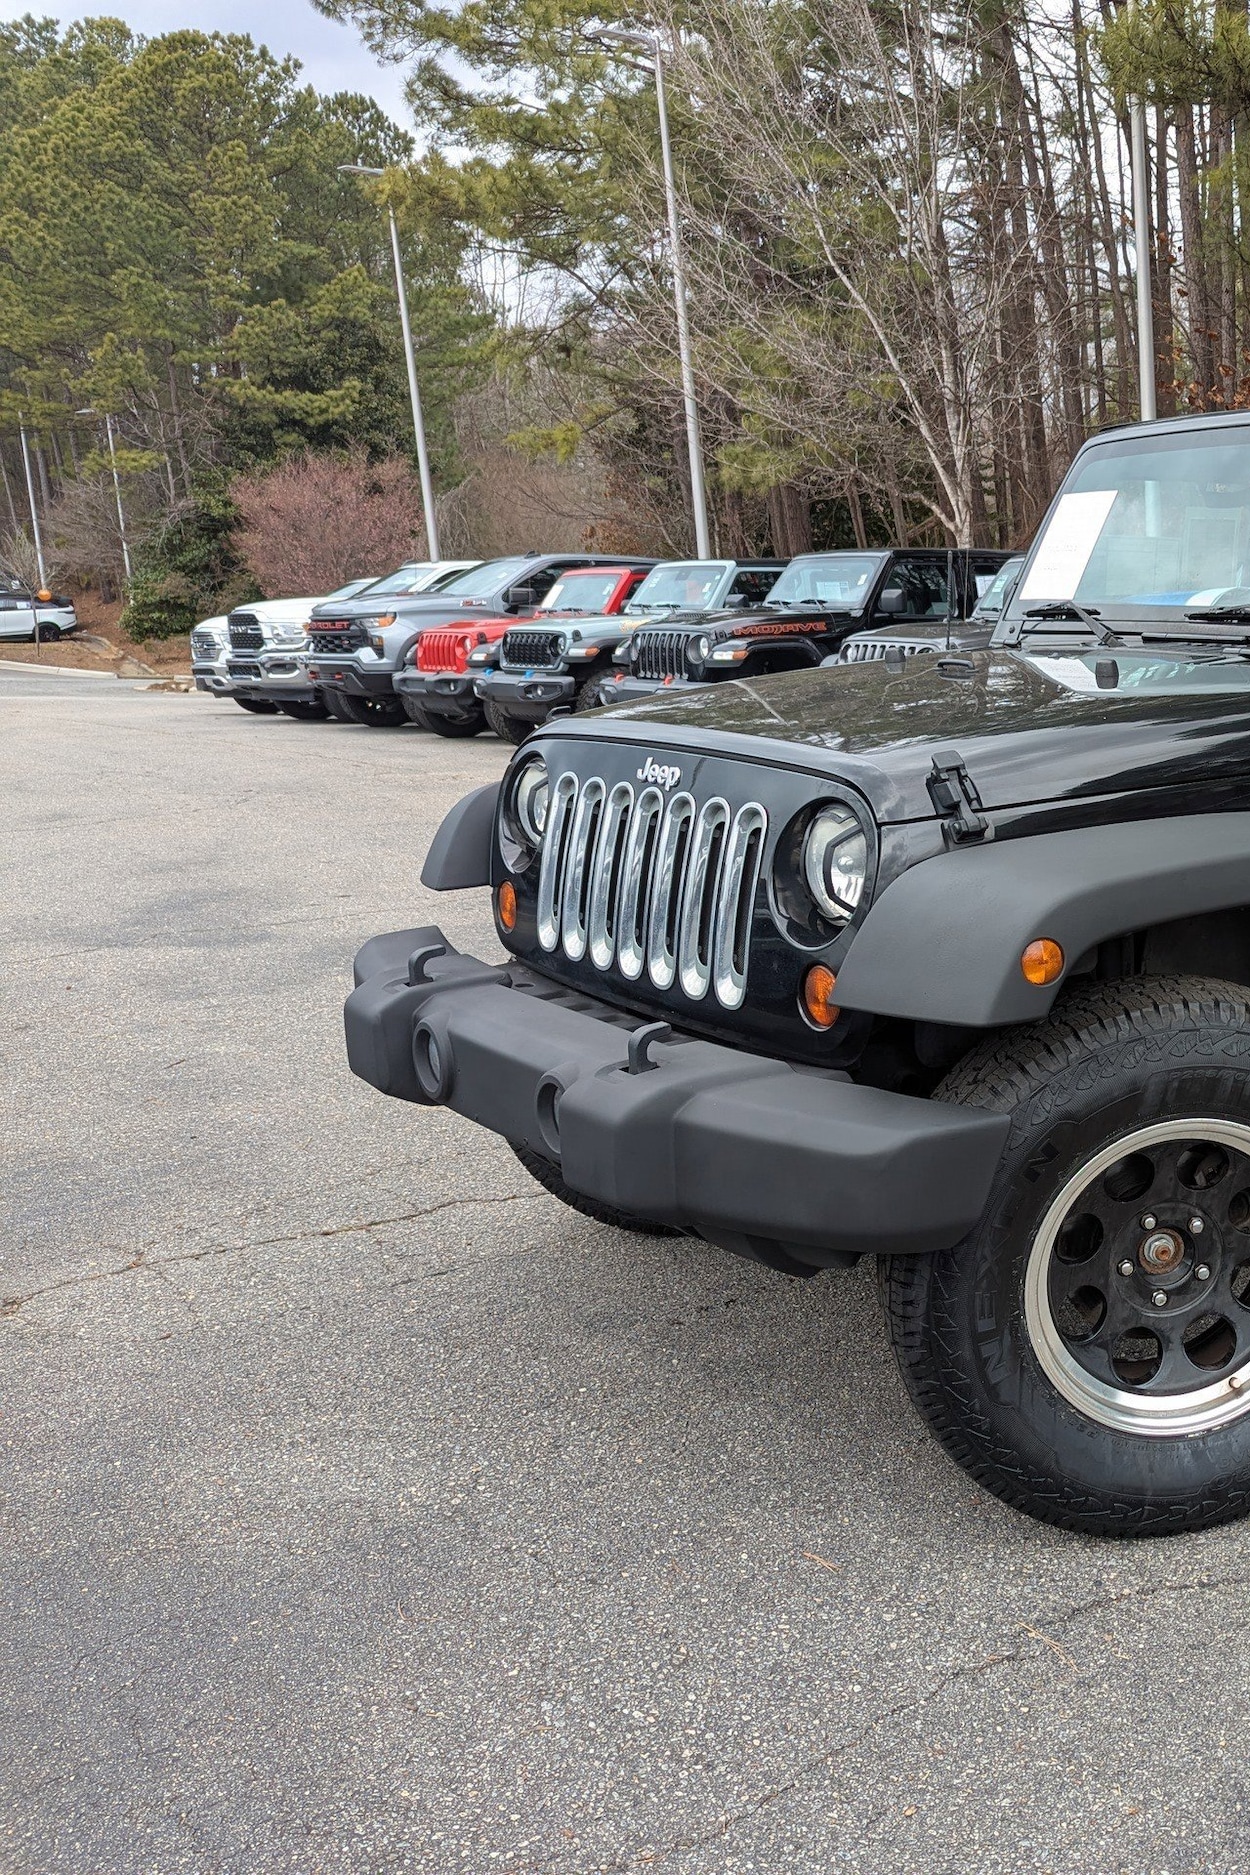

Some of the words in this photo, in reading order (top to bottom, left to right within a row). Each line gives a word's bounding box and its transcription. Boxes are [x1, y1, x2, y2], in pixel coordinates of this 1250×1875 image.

[731, 621, 827, 637] MOJAVE
[636, 756, 681, 792] Jeep
[973, 1136, 1062, 1385] NEXEN
